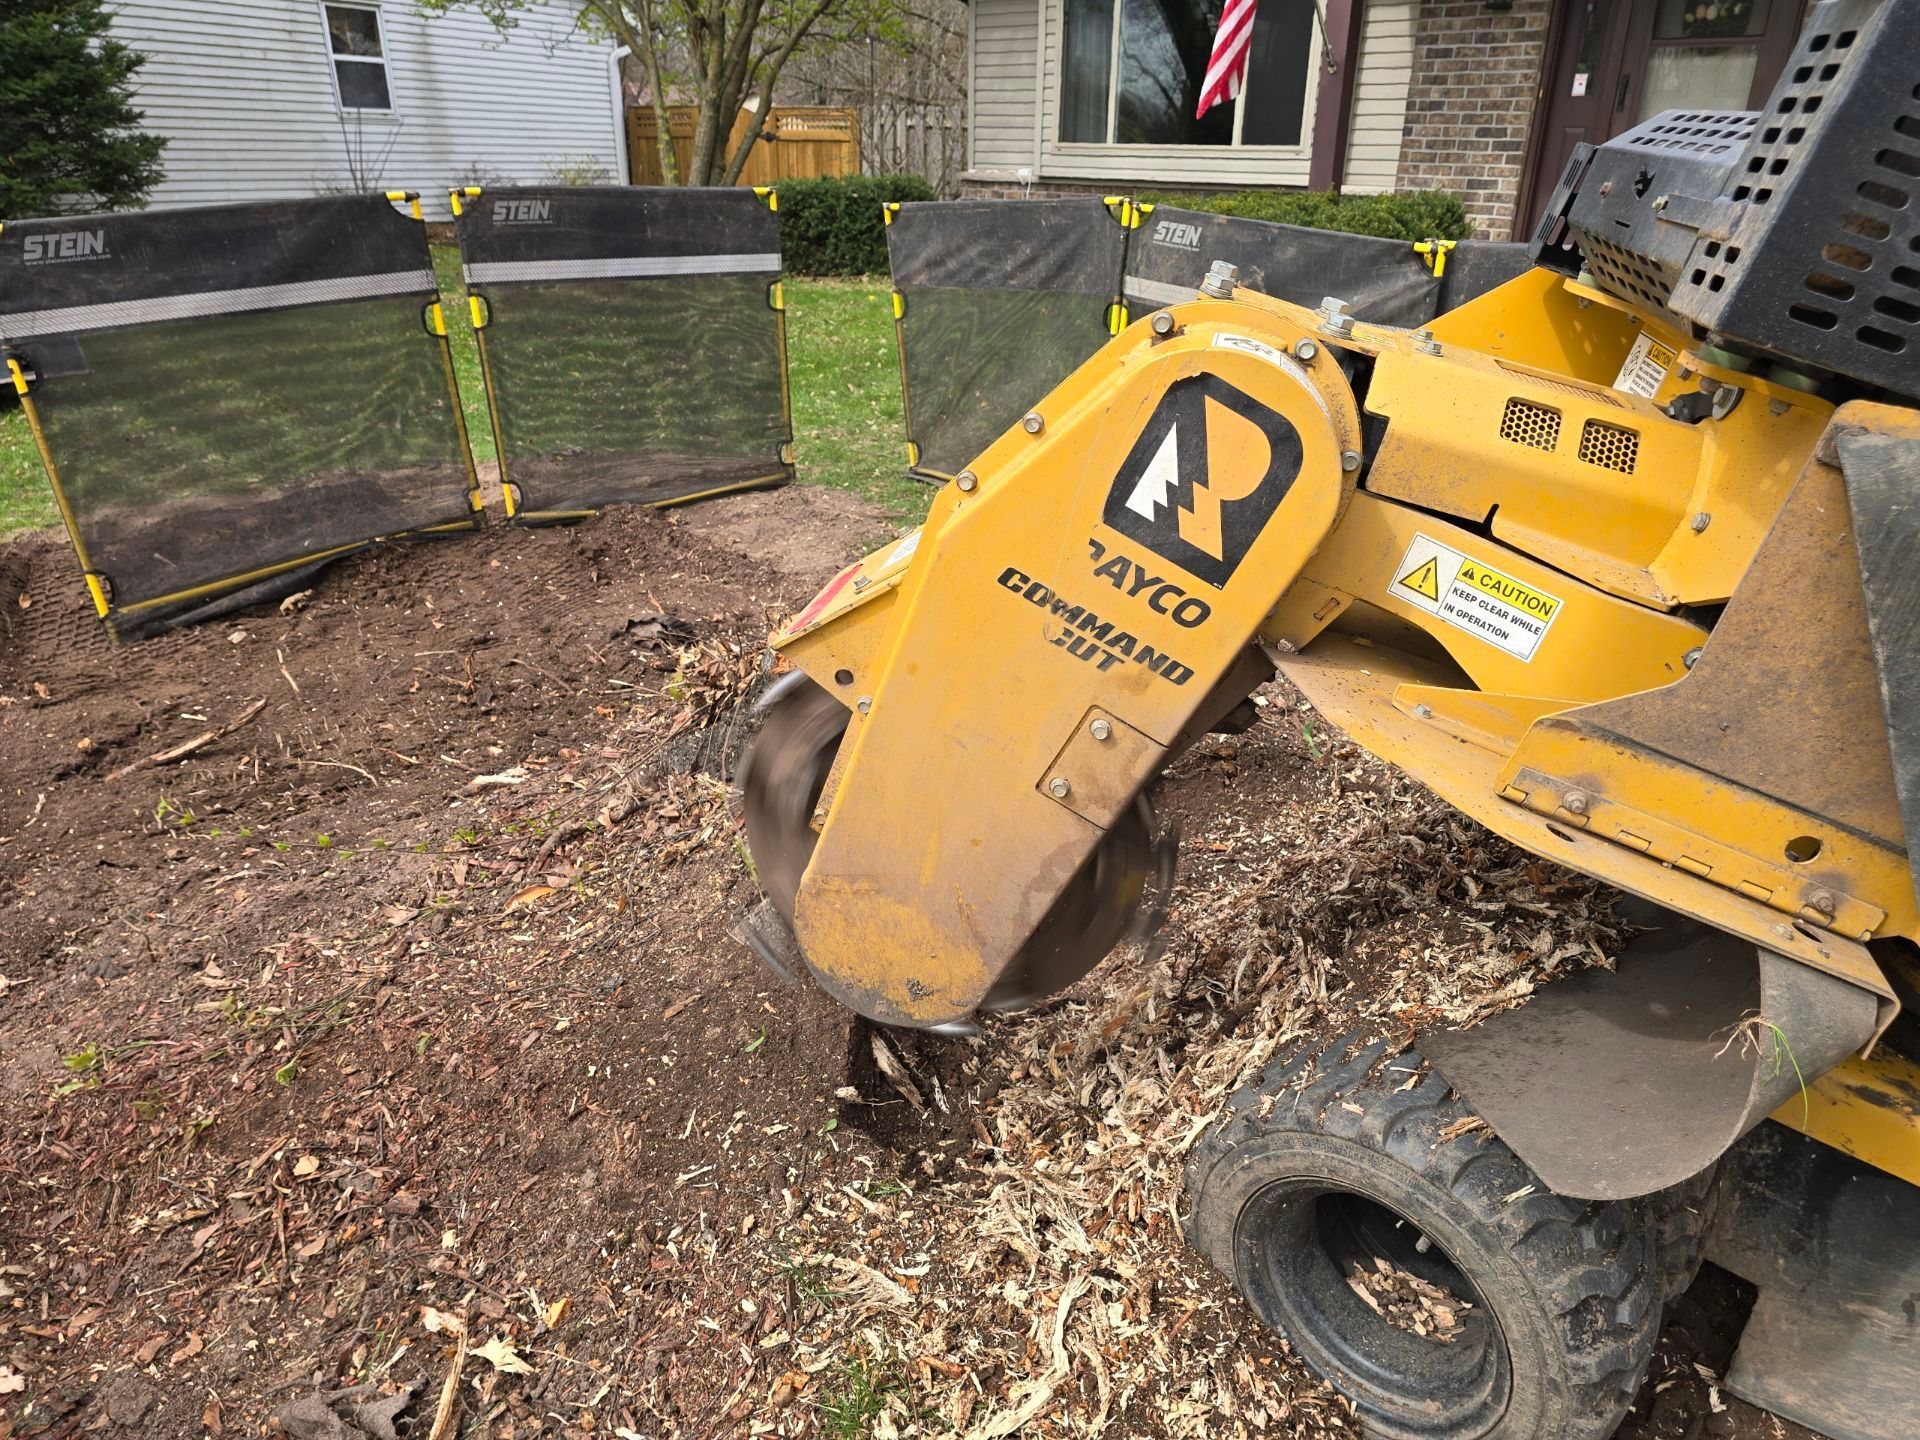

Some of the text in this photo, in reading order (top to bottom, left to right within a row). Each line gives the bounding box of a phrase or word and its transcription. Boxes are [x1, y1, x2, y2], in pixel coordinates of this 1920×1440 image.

[492, 200, 551, 220] STEIN
[23, 230, 104, 260] STEIN
[1153, 220, 1203, 247] STEIN
[1452, 586, 1542, 636] KEEP CLEAR WHILE
[1480, 574, 1553, 616] CAUTION
[997, 567, 1195, 685] COMMAND
[1444, 603, 1511, 640] IN OPERATION
